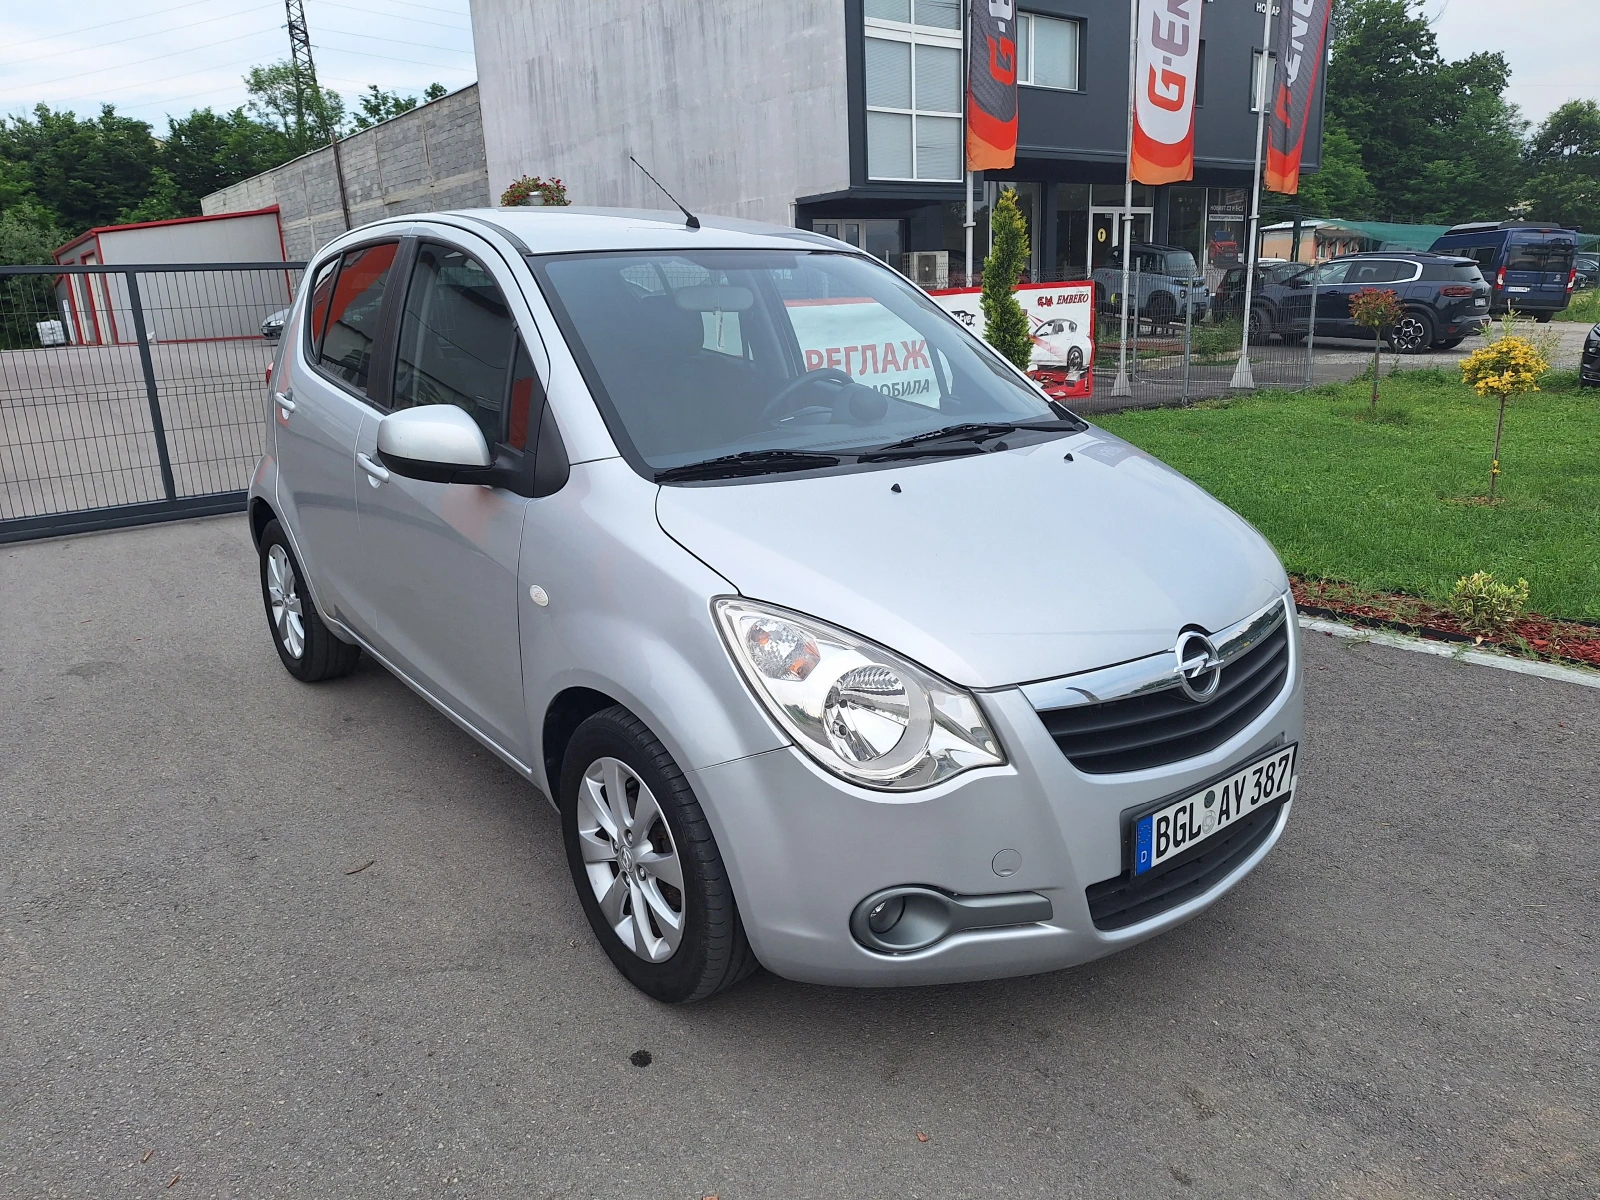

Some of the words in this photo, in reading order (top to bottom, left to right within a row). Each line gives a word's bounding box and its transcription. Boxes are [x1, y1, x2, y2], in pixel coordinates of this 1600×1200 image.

[1057, 293, 1089, 305] EMBEKO
[805, 339, 930, 376] РЕГЛАЖ
[1155, 802, 1201, 859] BGL
[1217, 775, 1247, 826] AY
[1250, 753, 1290, 806] 387
[1140, 850, 1148, 863] D
